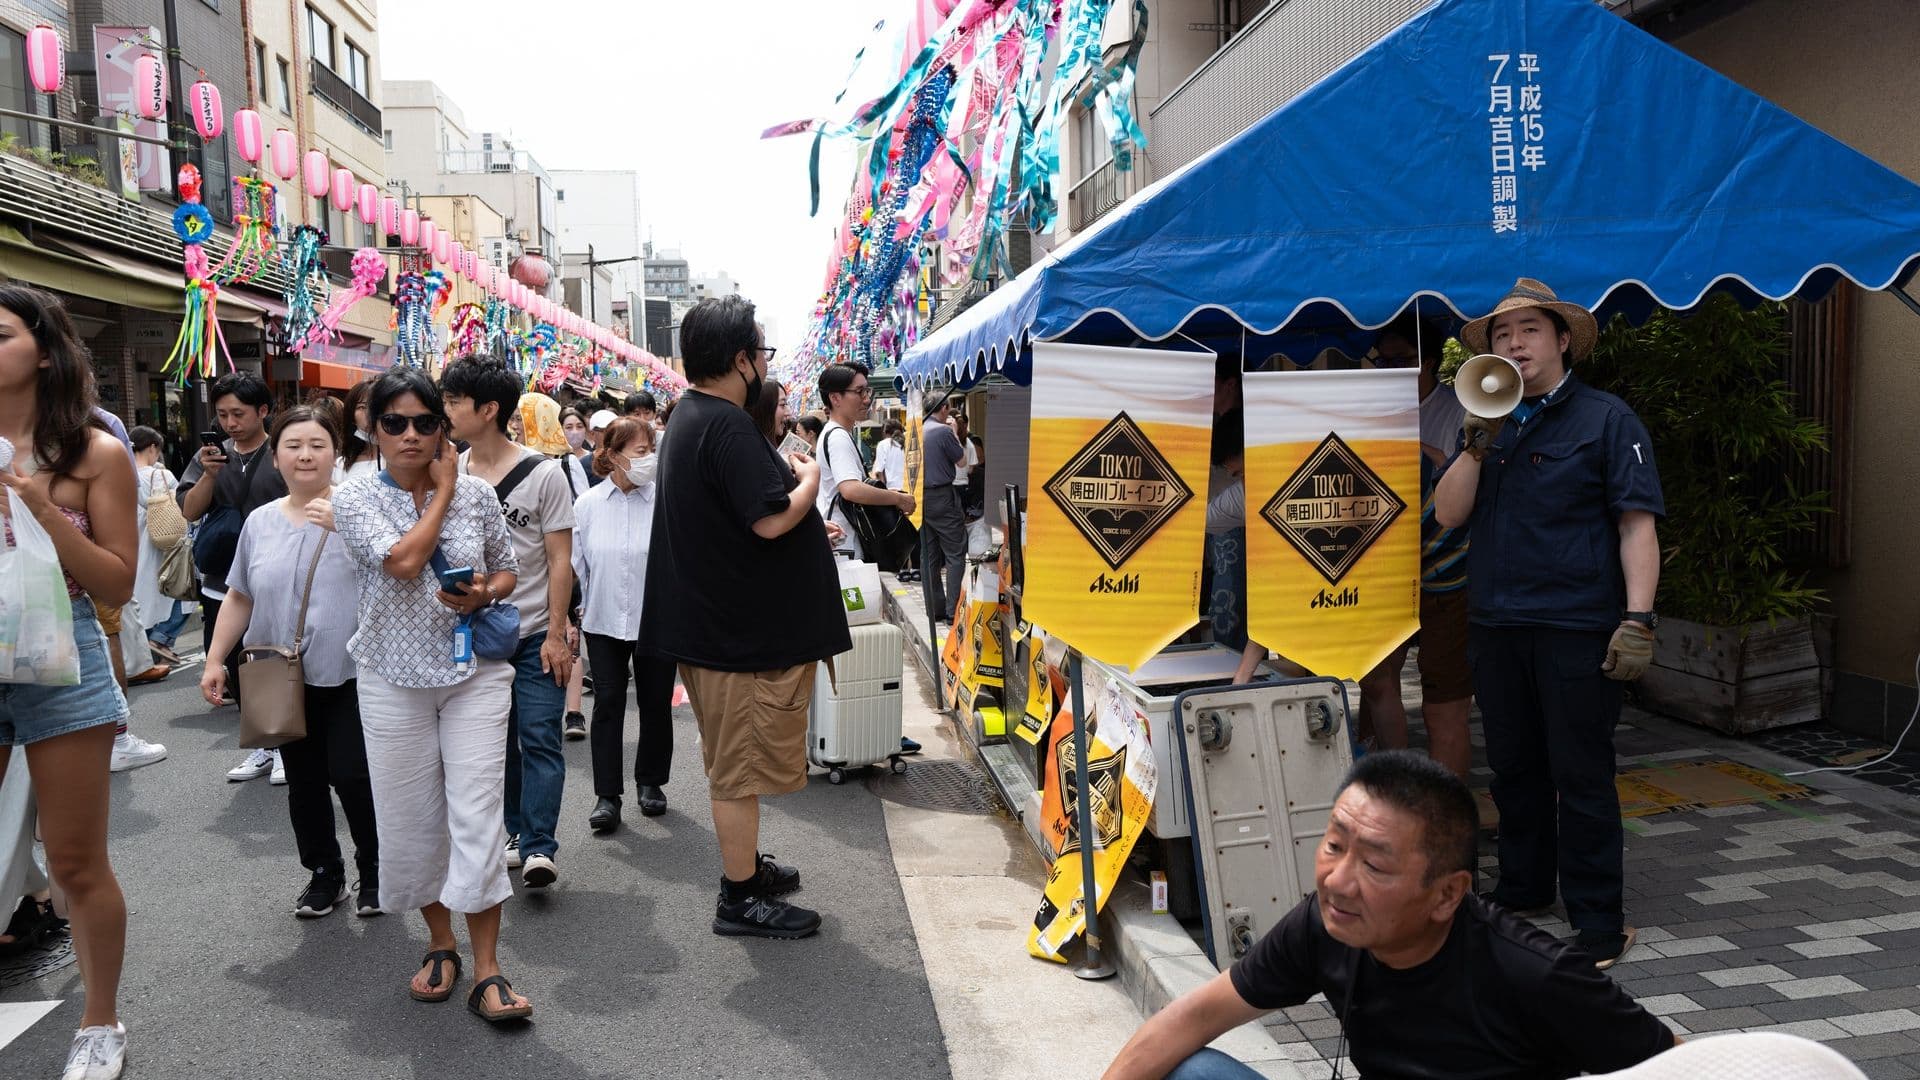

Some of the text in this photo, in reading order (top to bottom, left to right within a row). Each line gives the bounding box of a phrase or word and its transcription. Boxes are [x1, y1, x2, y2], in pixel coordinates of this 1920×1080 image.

[1518, 53, 1546, 172] 平成15年
[1488, 54, 1518, 234] 7月吉日調製
[1099, 454, 1142, 479] TOKYO
[1070, 481, 1167, 503] 隅田川ブルーイング
[1312, 474, 1353, 497] TOKYO
[1286, 498, 1380, 521] 隅田川ブルーイング
[1089, 573, 1140, 594] Asahi
[1310, 587, 1359, 609] Asahi
